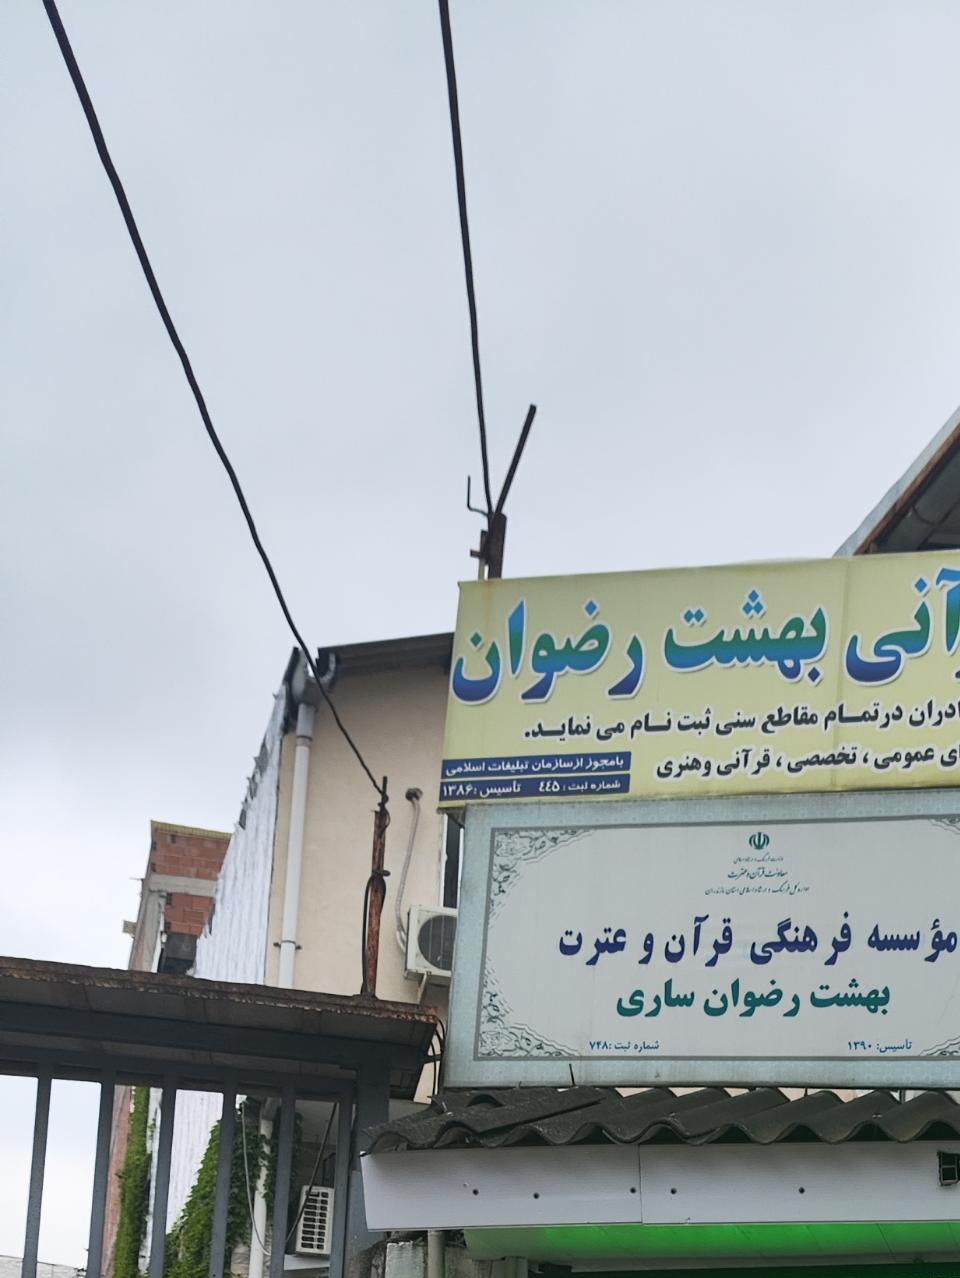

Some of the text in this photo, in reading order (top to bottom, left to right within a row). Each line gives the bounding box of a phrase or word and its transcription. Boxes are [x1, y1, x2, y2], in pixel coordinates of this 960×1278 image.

[665, 590, 828, 683] بهشت
[452, 600, 643, 702] رضوان
[630, 712, 672, 739] نام
[677, 708, 711, 735] ثبت
[715, 712, 756, 735] سنی
[761, 706, 818, 733] مقاطع
[445, 762, 486, 776] اسلامی
[488, 761, 529, 773] تبلیغات
[716, 748, 770, 776] قرآنی
[590, 780, 621, 791] شماره
[559, 911, 958, 967] مؤسسه فرهنگی قرآن و عترت
[616, 978, 890, 1017] بهشت رضوان ساری
[614, 1041, 631, 1052] ثبت
[633, 1040, 660, 1053] شماره
[847, 1041, 872, 1050] ۱۳۹۰
